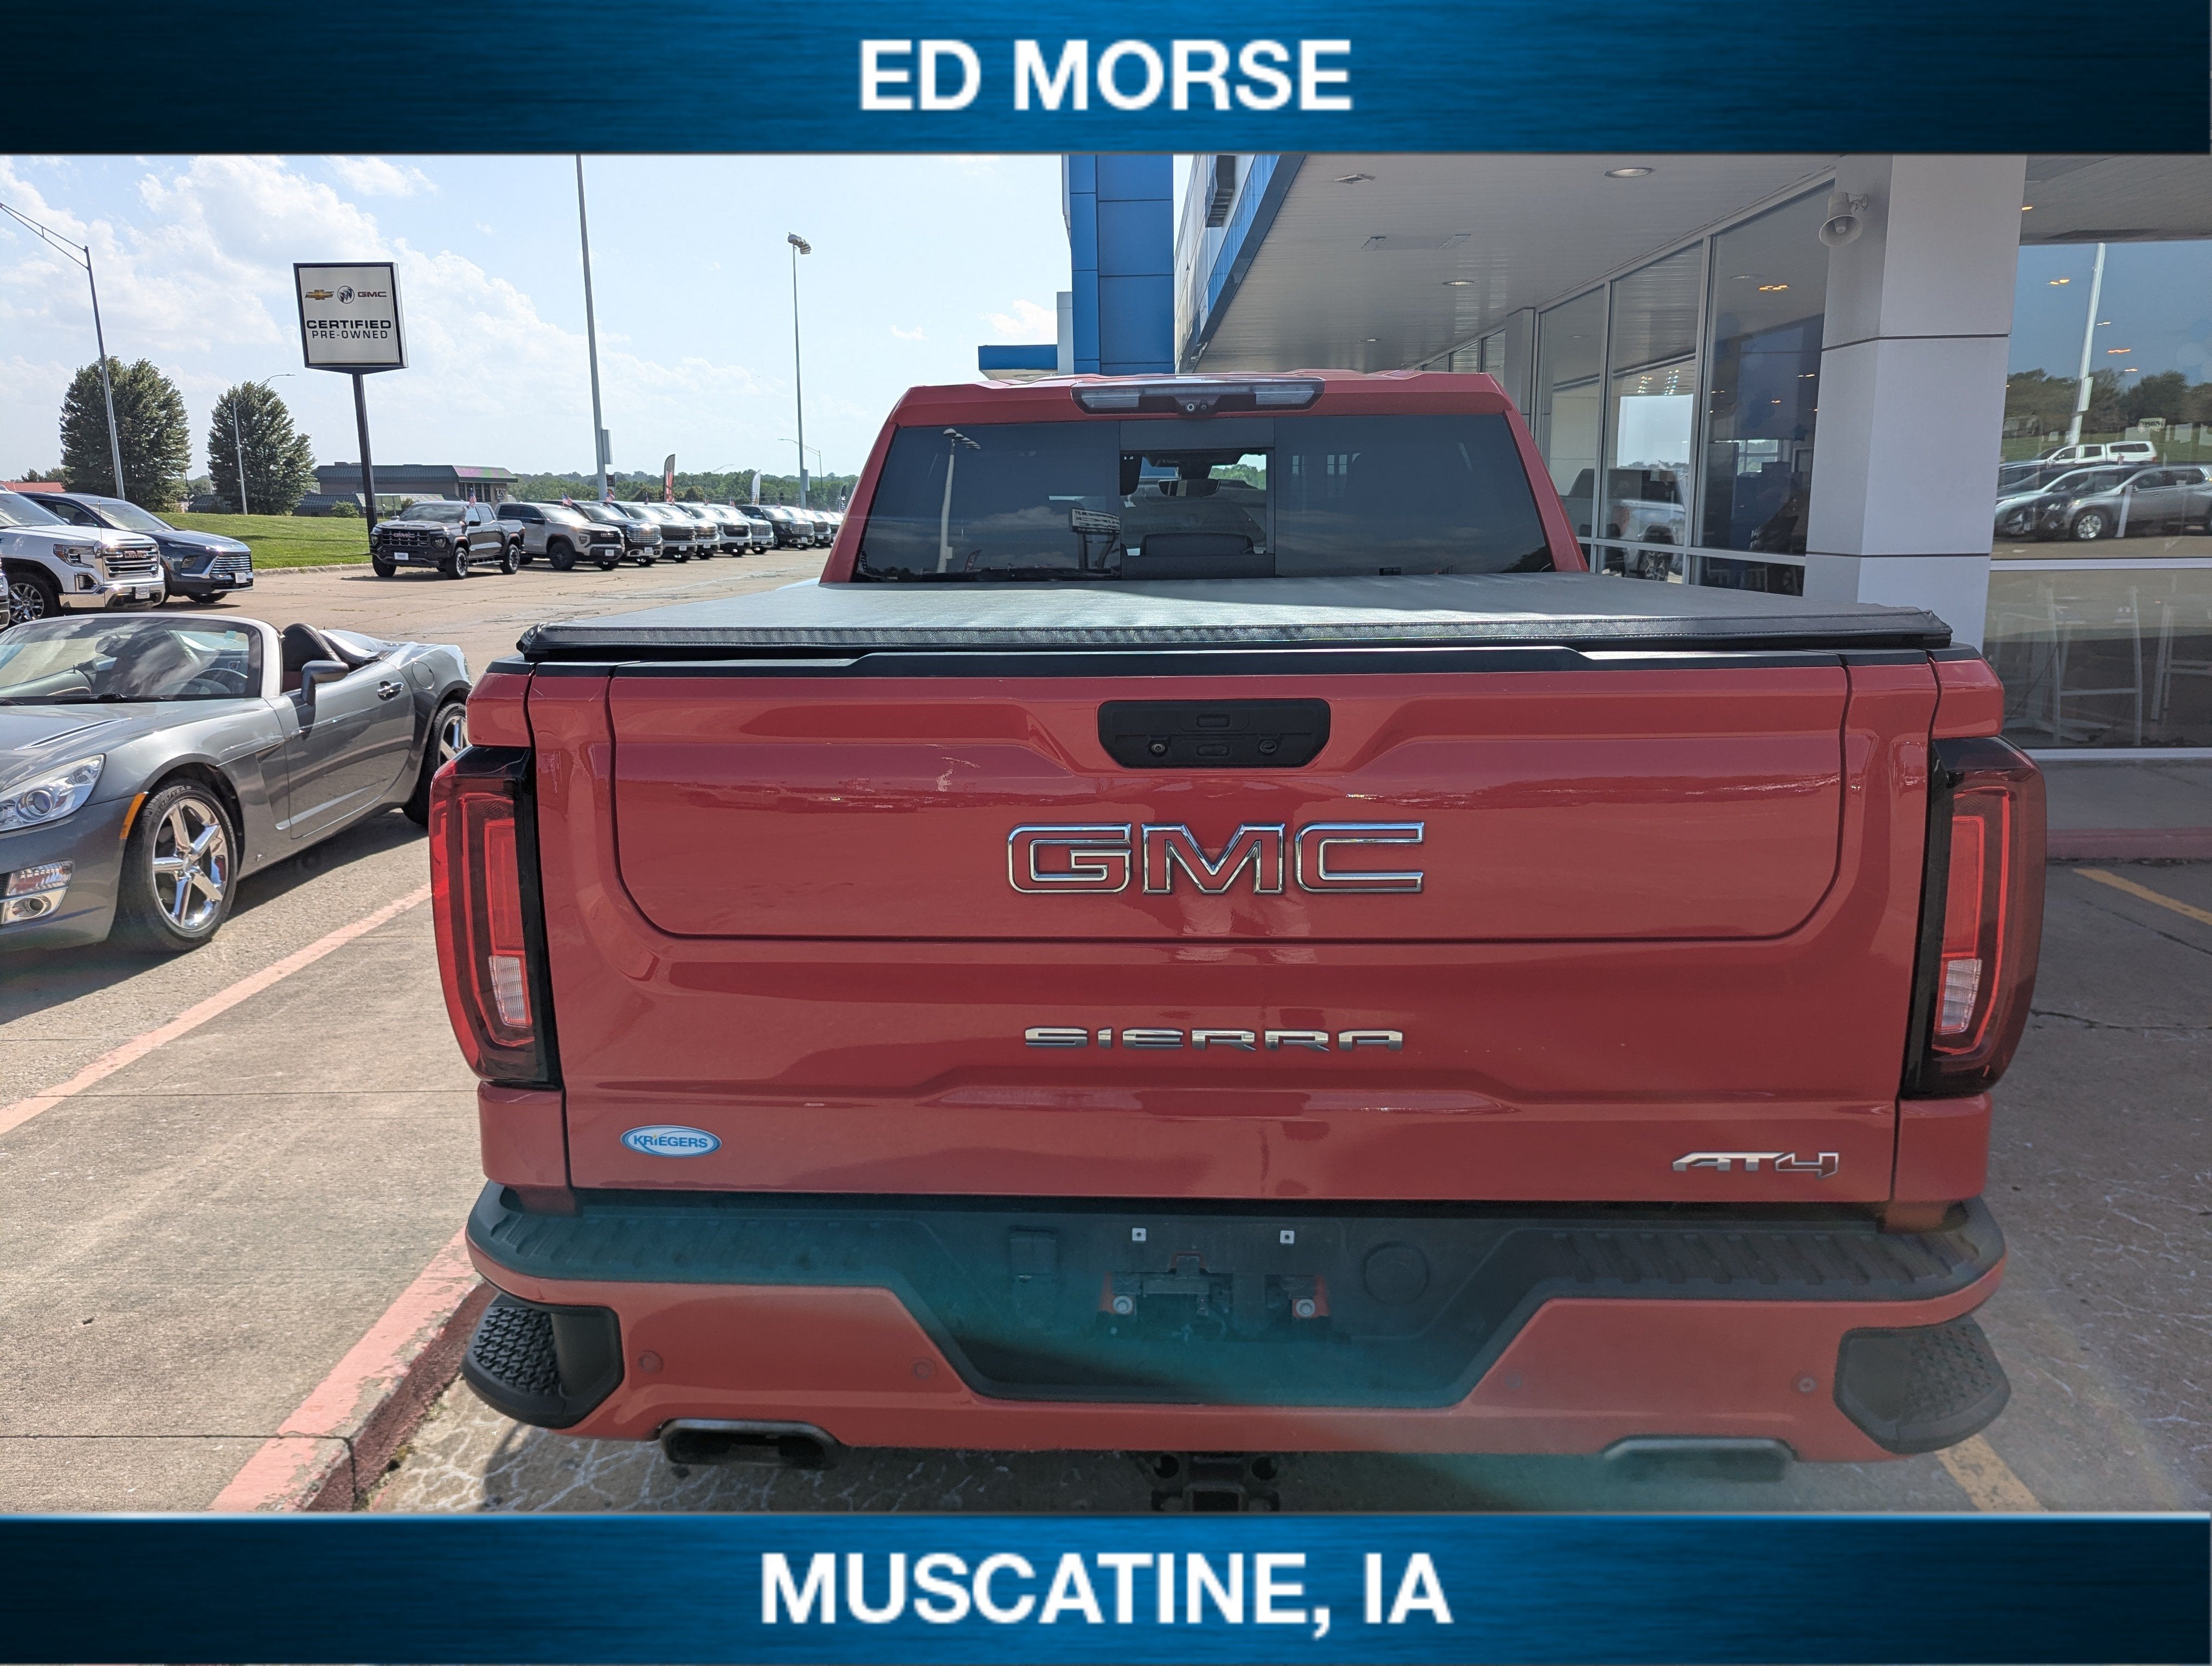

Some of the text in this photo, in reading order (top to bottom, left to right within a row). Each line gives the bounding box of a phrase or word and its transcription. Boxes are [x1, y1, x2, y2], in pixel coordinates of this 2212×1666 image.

[306, 320, 391, 329] CERTIFIED
[312, 330, 388, 339] PRE-OWNED
[1006, 822, 1424, 894] GMC
[1025, 1027, 1404, 1052] SIERRA
[1672, 1151, 1840, 1179] AT4
